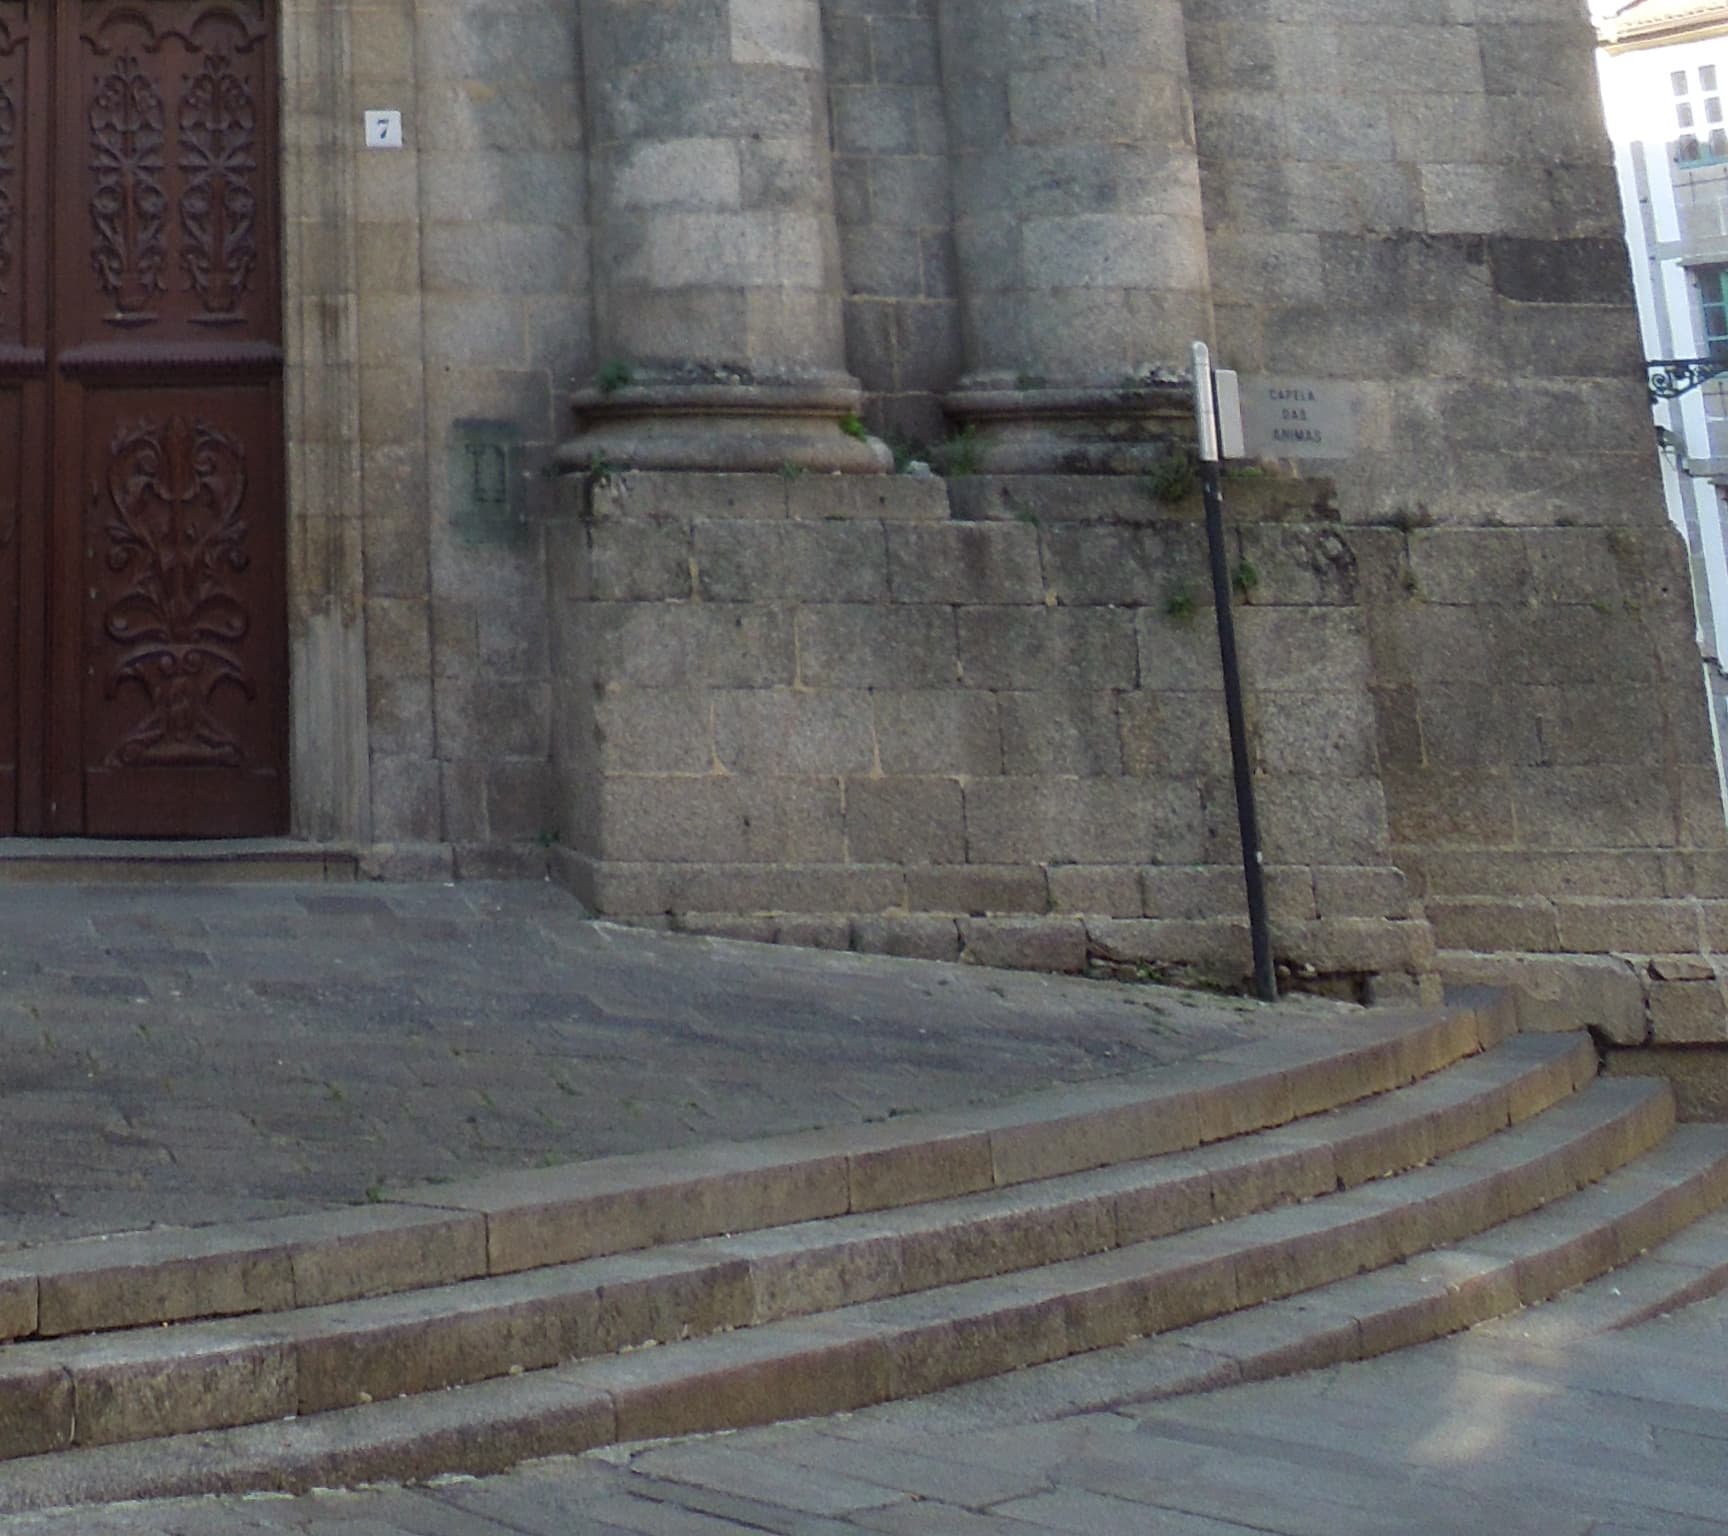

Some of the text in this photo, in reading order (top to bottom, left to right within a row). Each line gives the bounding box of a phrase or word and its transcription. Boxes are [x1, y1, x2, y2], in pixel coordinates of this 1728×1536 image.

[377, 119, 389, 139] 7
[1269, 389, 1316, 401] CAPELA
[1282, 408, 1307, 421] DAS
